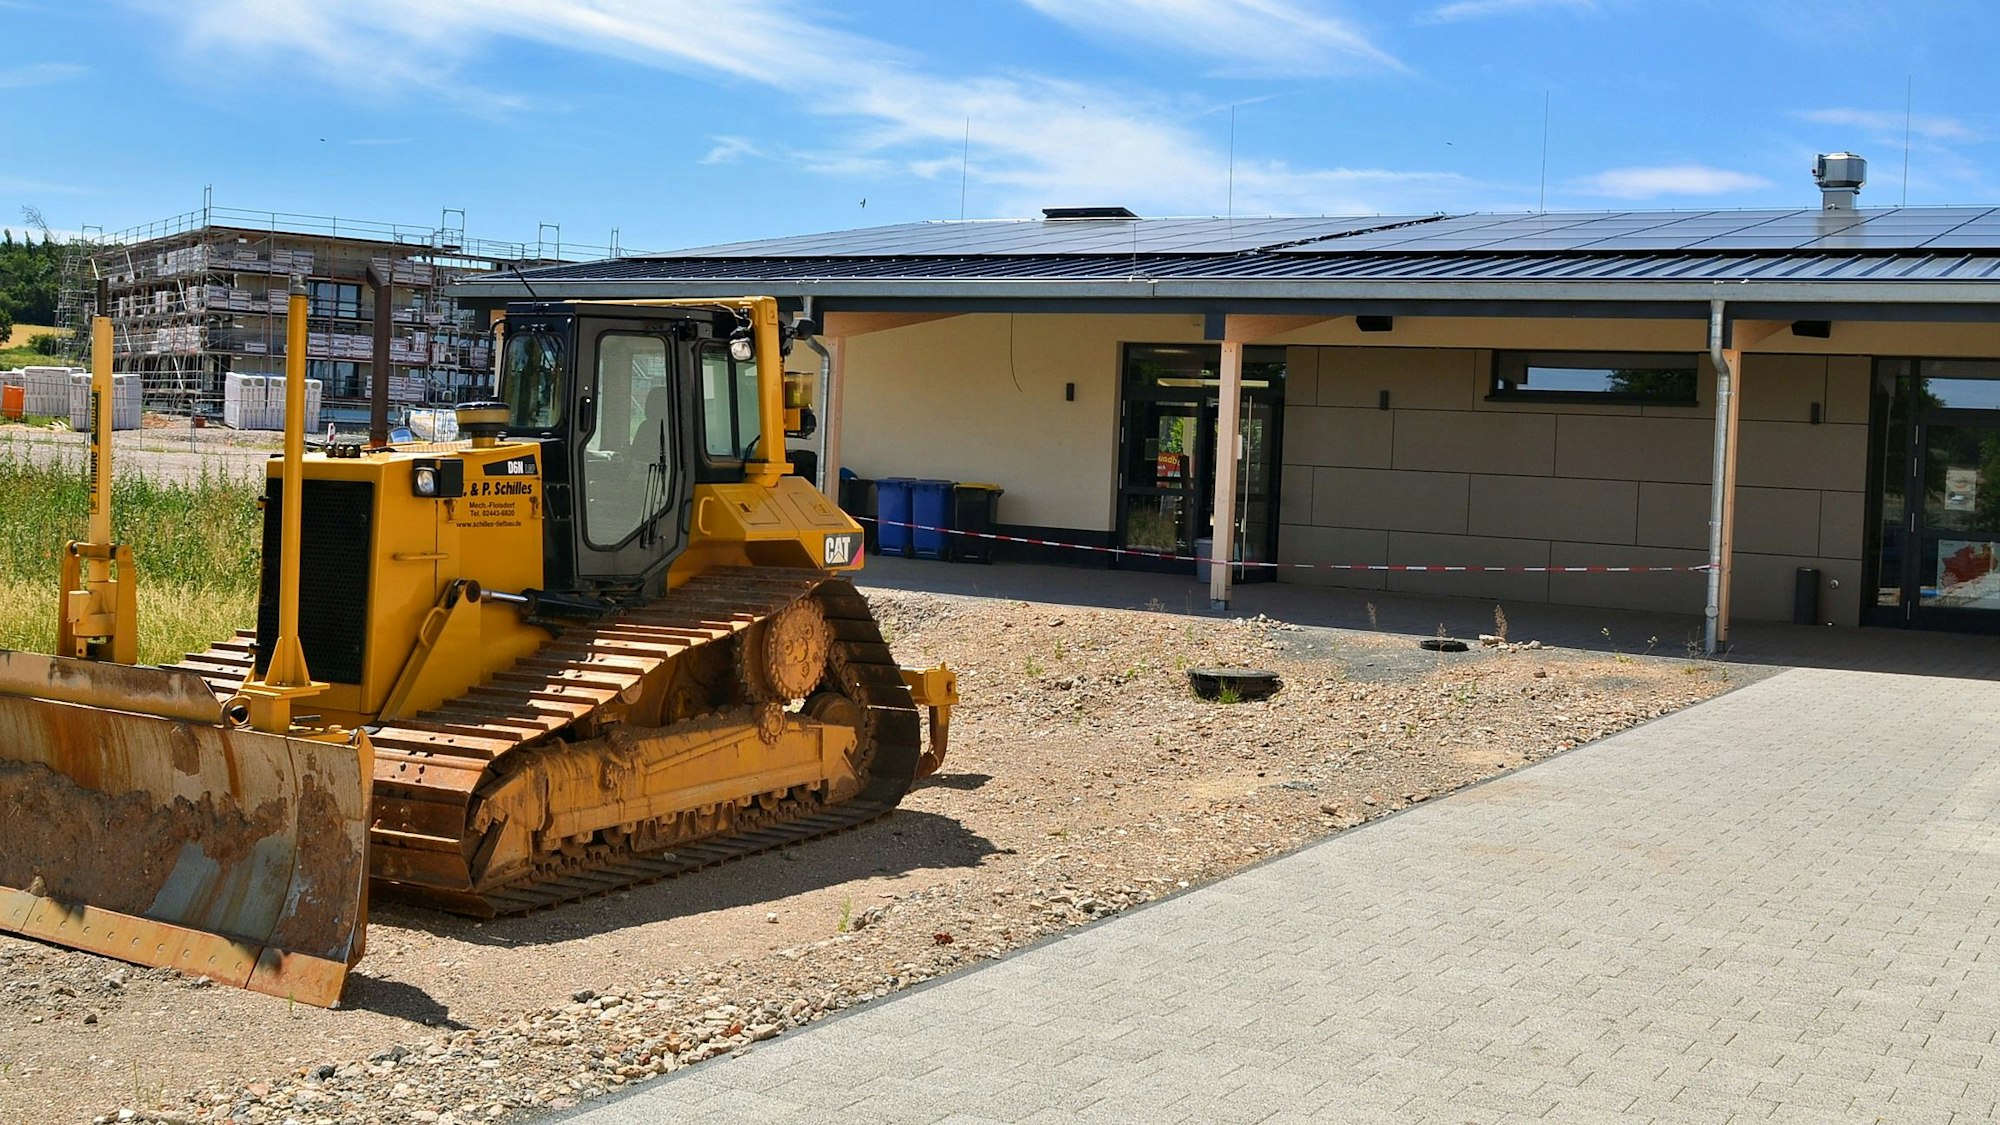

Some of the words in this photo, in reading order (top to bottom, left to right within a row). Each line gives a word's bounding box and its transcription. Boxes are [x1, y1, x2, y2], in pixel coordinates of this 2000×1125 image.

[507, 460, 524, 474] D6N
[470, 482, 479, 497] &
[482, 482, 491, 496] P.
[494, 481, 532, 495] Schilles
[825, 536, 851, 565] CAT
